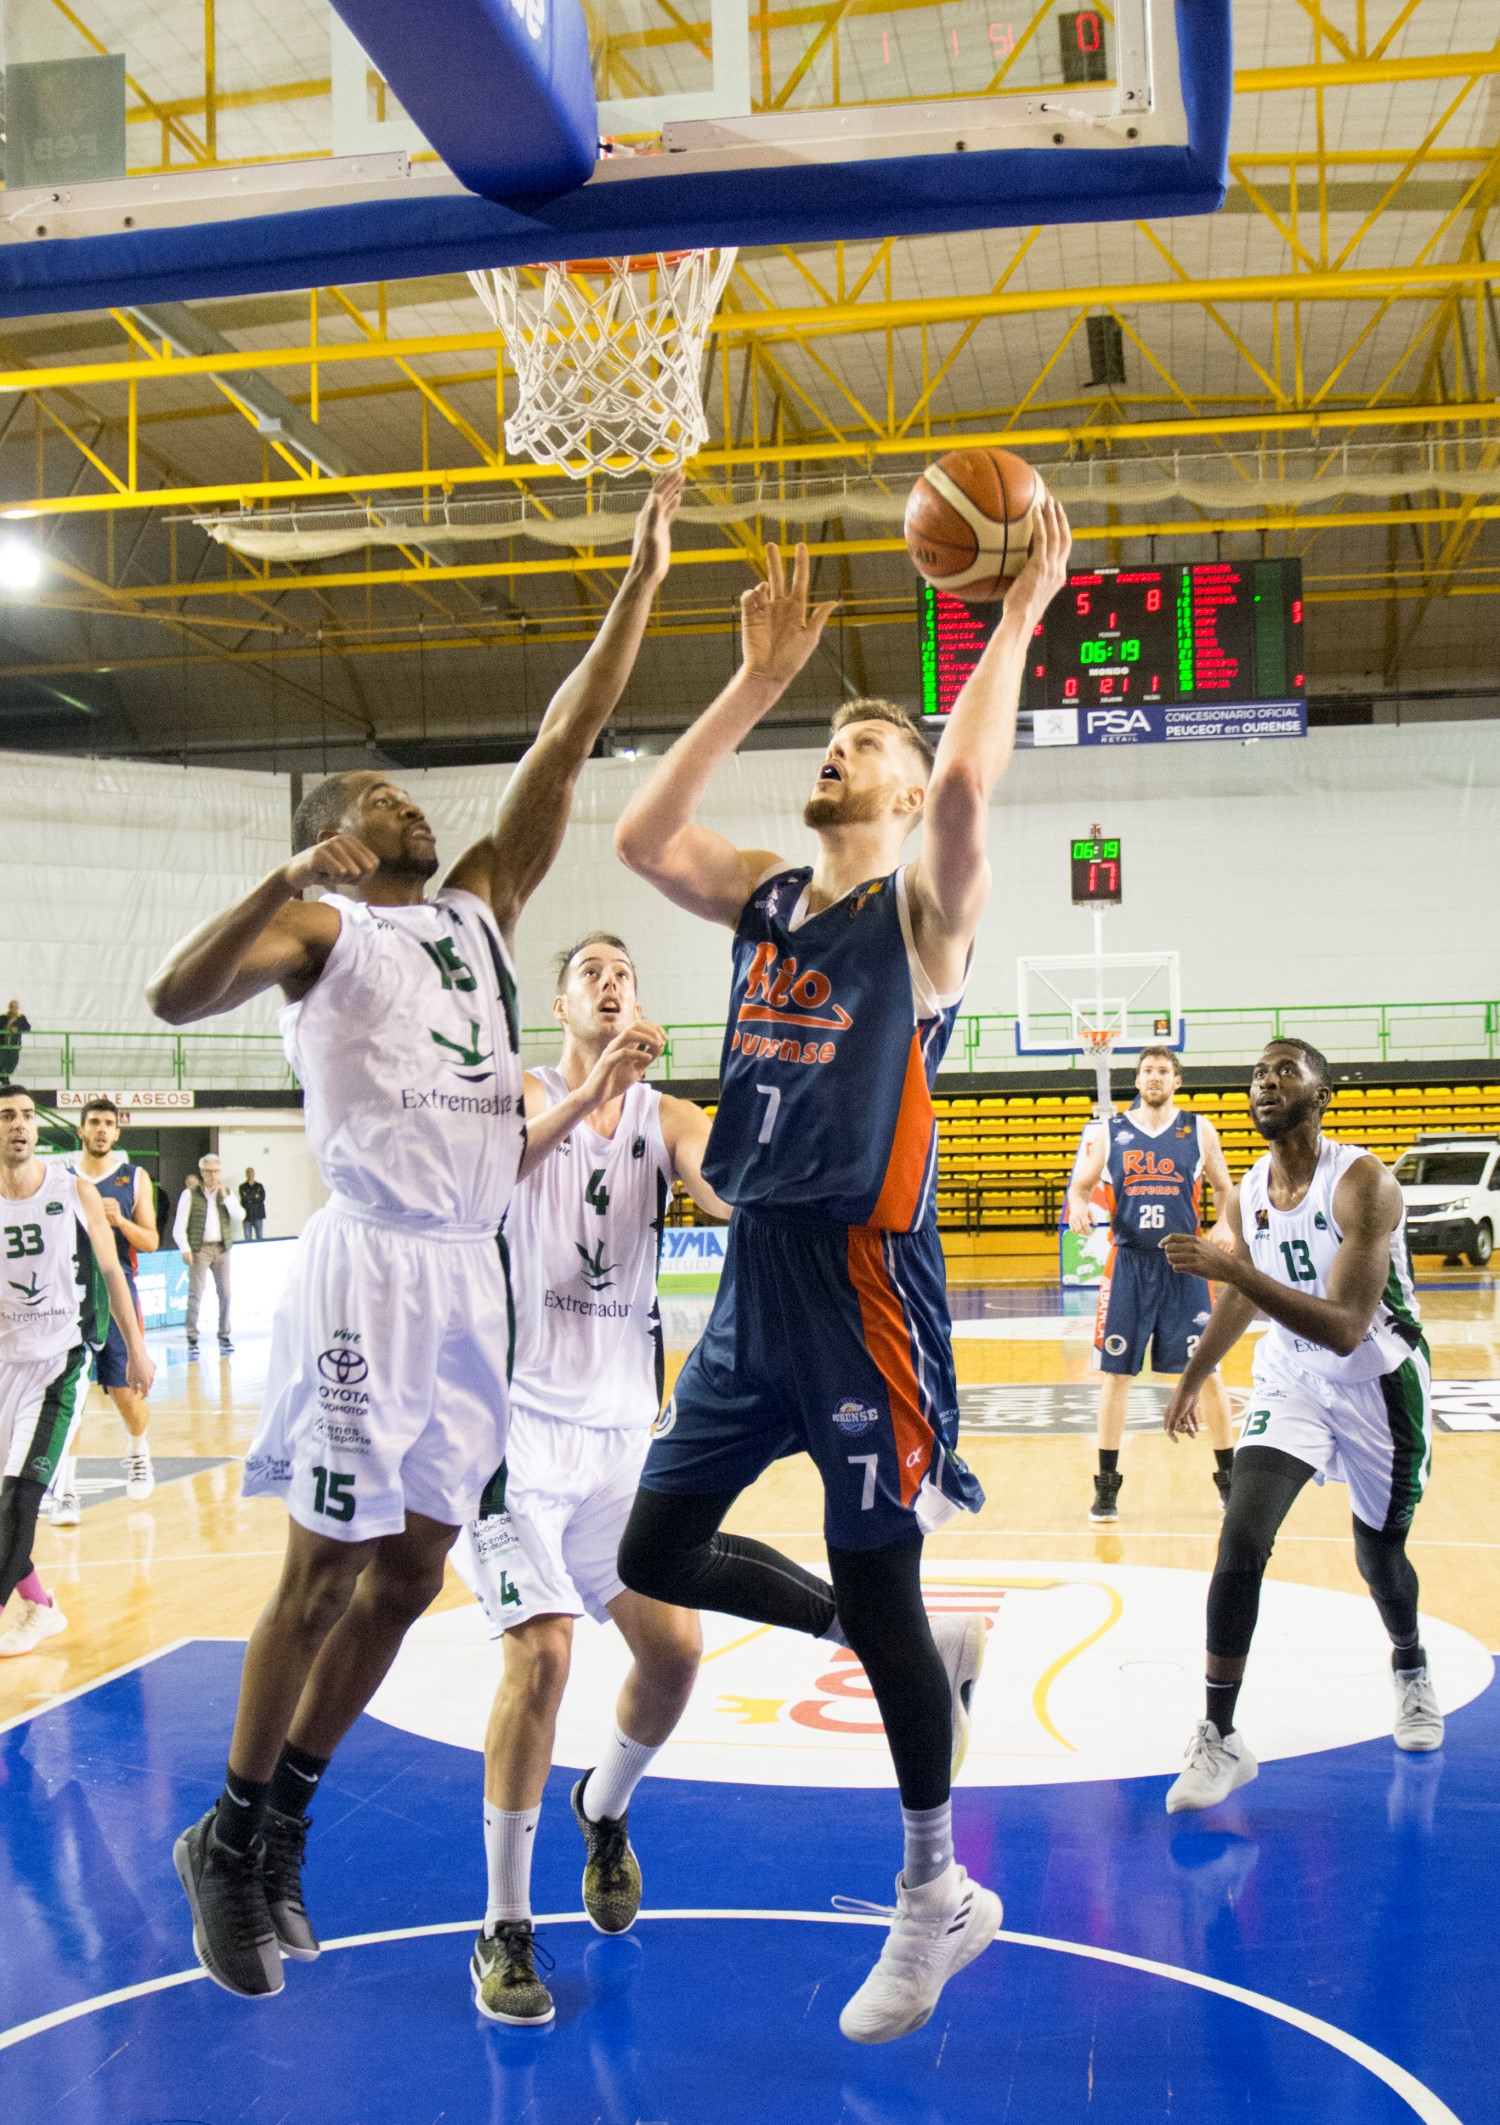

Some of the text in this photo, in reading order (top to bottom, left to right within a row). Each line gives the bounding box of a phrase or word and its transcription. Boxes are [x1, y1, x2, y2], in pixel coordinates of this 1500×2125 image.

[1076, 591, 1091, 615] 5
[1145, 588, 1162, 612] 8
[1080, 639, 1140, 664] 06:19
[1064, 677, 1078, 697] 0
[1087, 709, 1152, 734] PSA
[1165, 707, 1299, 722] CONCESIONARIO OFICIAL
[1100, 735, 1138, 743] RETAIL
[1166, 720, 1301, 736] PEUGEOT en OURENSE
[1073, 841, 1119, 860] 06:19
[1088, 862, 1118, 892] 17
[419, 936, 477, 992] 15
[744, 942, 831, 1009] Rio
[132, 1093, 190, 1105] ASEOS
[756, 1083, 781, 1144] 7
[1122, 1149, 1175, 1175] Rio
[585, 1169, 610, 1215] 4
[1139, 1204, 1165, 1229] 26
[4, 1223, 45, 1259] 33
[1279, 1239, 1317, 1282] 13
[1186, 1334, 1200, 1358] 2
[318, 1385, 369, 1404] OYOTA
[312, 1465, 356, 1522] 15
[848, 1454, 878, 1510] 7
[500, 1570, 522, 1607] 4
